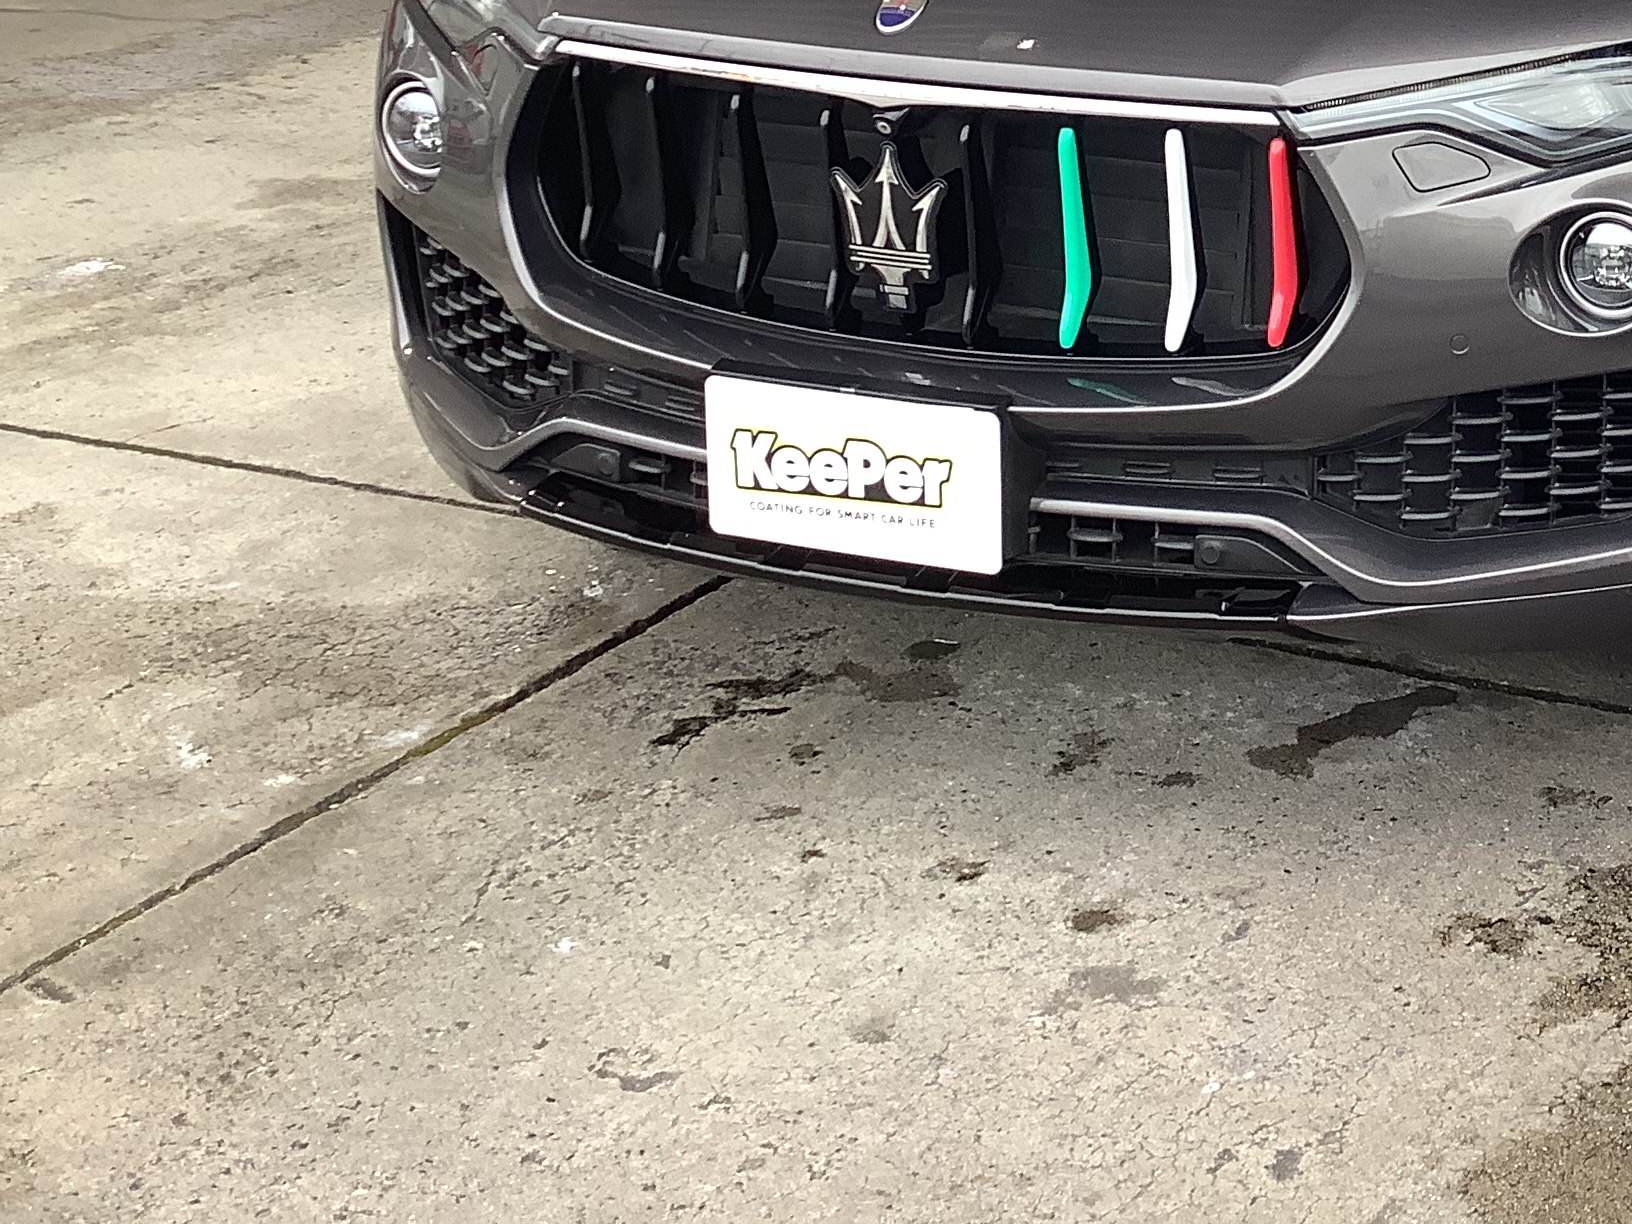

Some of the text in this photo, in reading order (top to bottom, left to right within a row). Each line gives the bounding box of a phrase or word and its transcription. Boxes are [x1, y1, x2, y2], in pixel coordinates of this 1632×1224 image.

[729, 427, 953, 509] KeePer
[749, 500, 936, 529] COATING FOR SMART CAR LIFE
